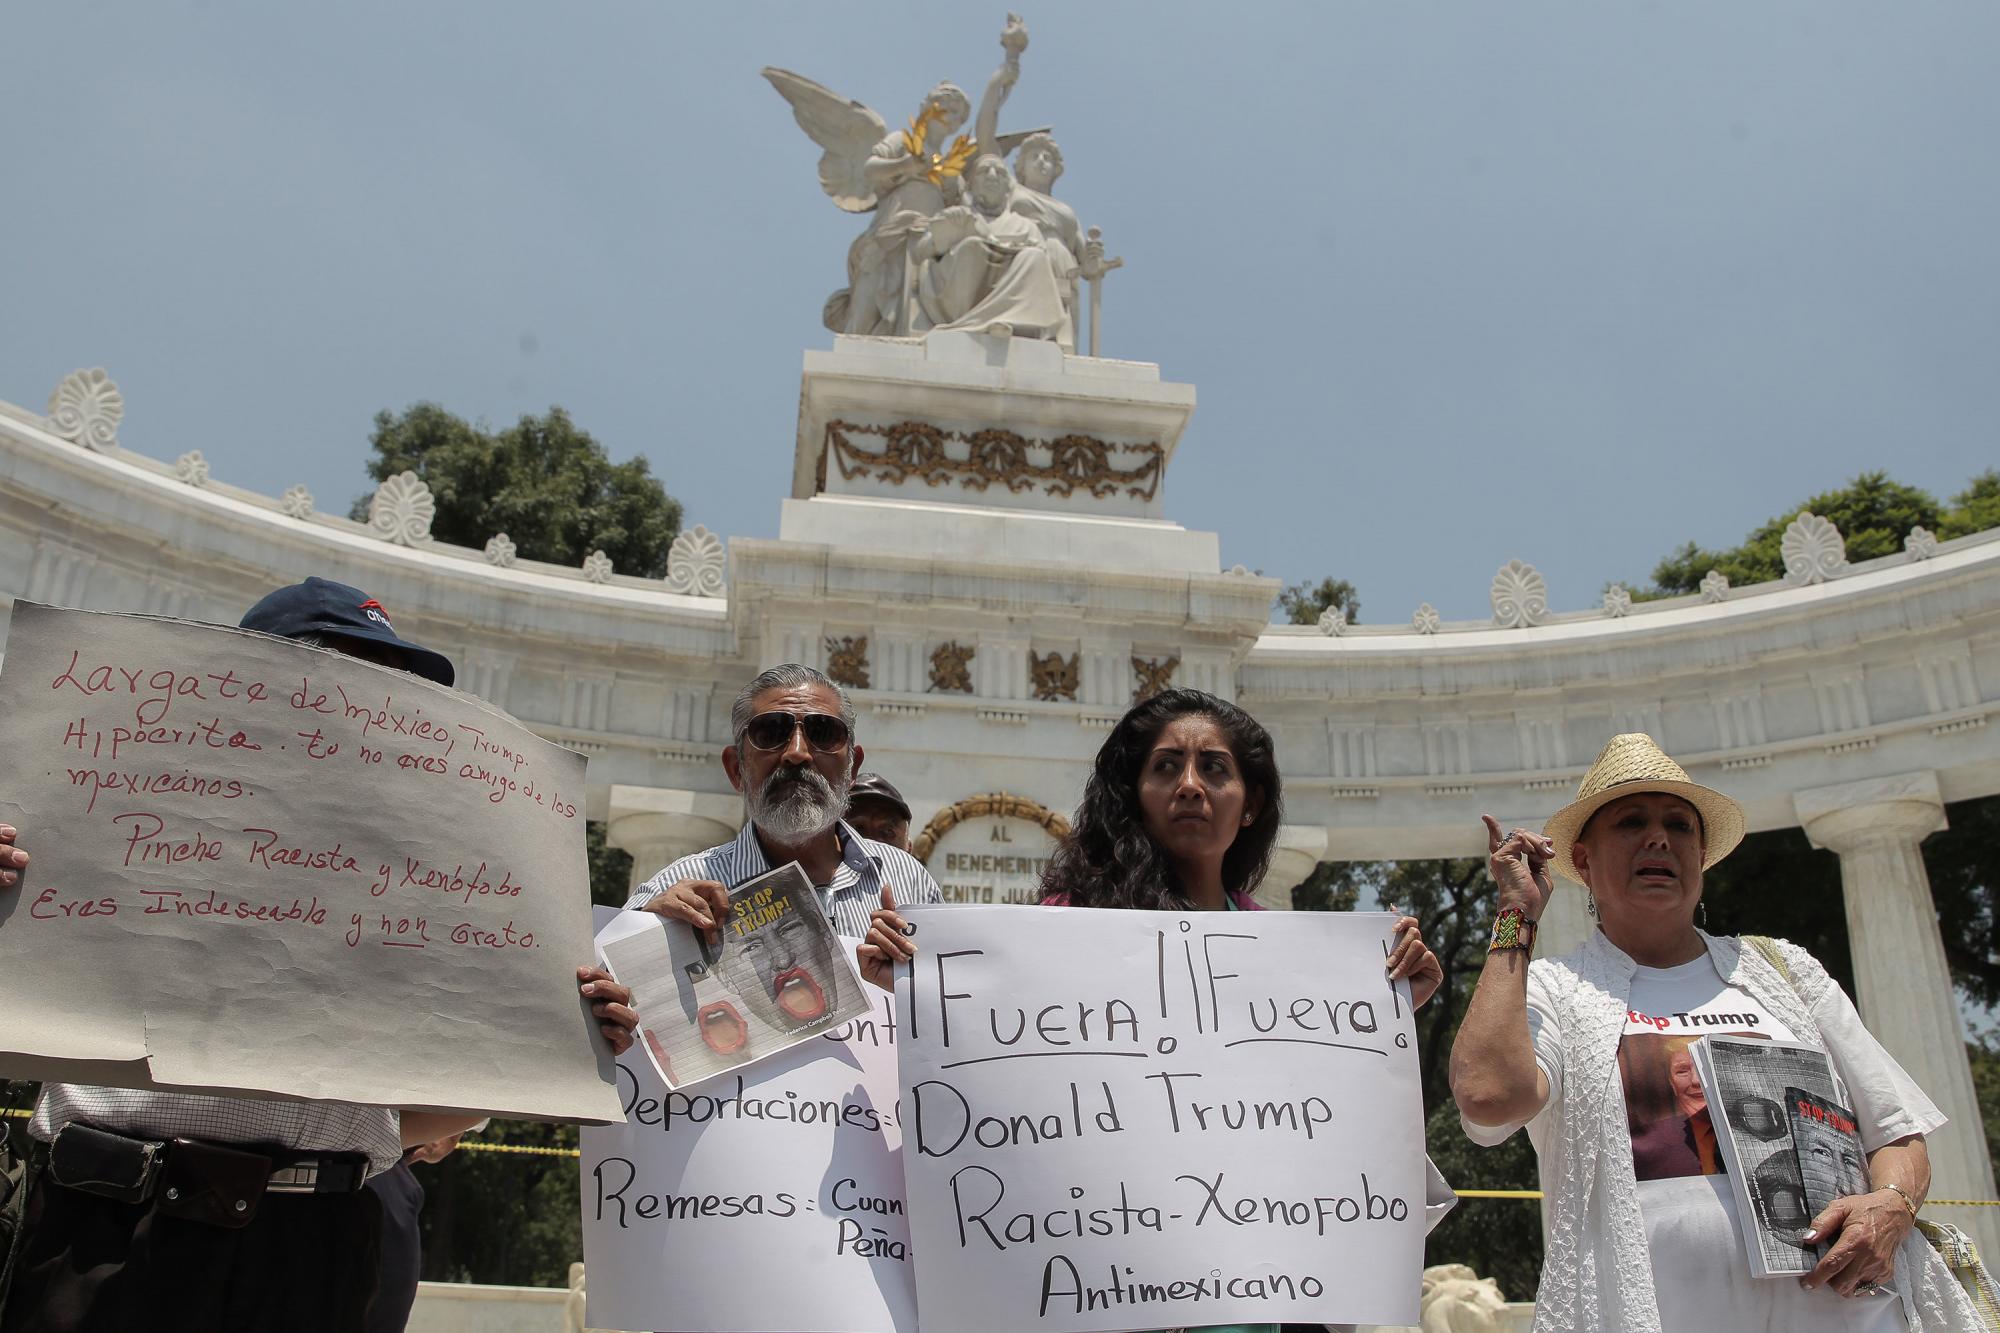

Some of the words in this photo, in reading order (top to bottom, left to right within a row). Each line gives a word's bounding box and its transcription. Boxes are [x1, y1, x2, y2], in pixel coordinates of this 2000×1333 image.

[52, 650, 268, 725] Largate
[291, 677, 336, 713] de
[458, 724, 528, 771] Trump.
[360, 746, 382, 764] no
[398, 754, 448, 774] eres
[460, 764, 516, 803] amigo
[523, 781, 545, 806] de
[552, 792, 577, 819] los
[990, 825, 1012, 843] AL
[113, 812, 222, 866] Pinche
[243, 829, 362, 872] Racista
[371, 865, 391, 896] y
[400, 857, 522, 903] Xenófobo
[946, 853, 1052, 874] BENEMERIT
[734, 887, 773, 917] STOP
[943, 884, 993, 904] ENITO
[1002, 888, 1037, 905] JUA
[30, 888, 118, 919] Eres
[140, 889, 327, 925] Indeseable
[345, 913, 362, 947] y
[381, 914, 430, 942] non
[450, 921, 540, 948] Grato.
[731, 896, 793, 936] TRUMP!
[808, 1012, 834, 1028] Campbell
[1625, 1010, 1670, 1031] top
[1672, 1012, 1760, 1028] Trump
[912, 1080, 1125, 1158] Donald
[1145, 1071, 1333, 1139] Trump
[1039, 1254, 1325, 1318] Antimexicano
